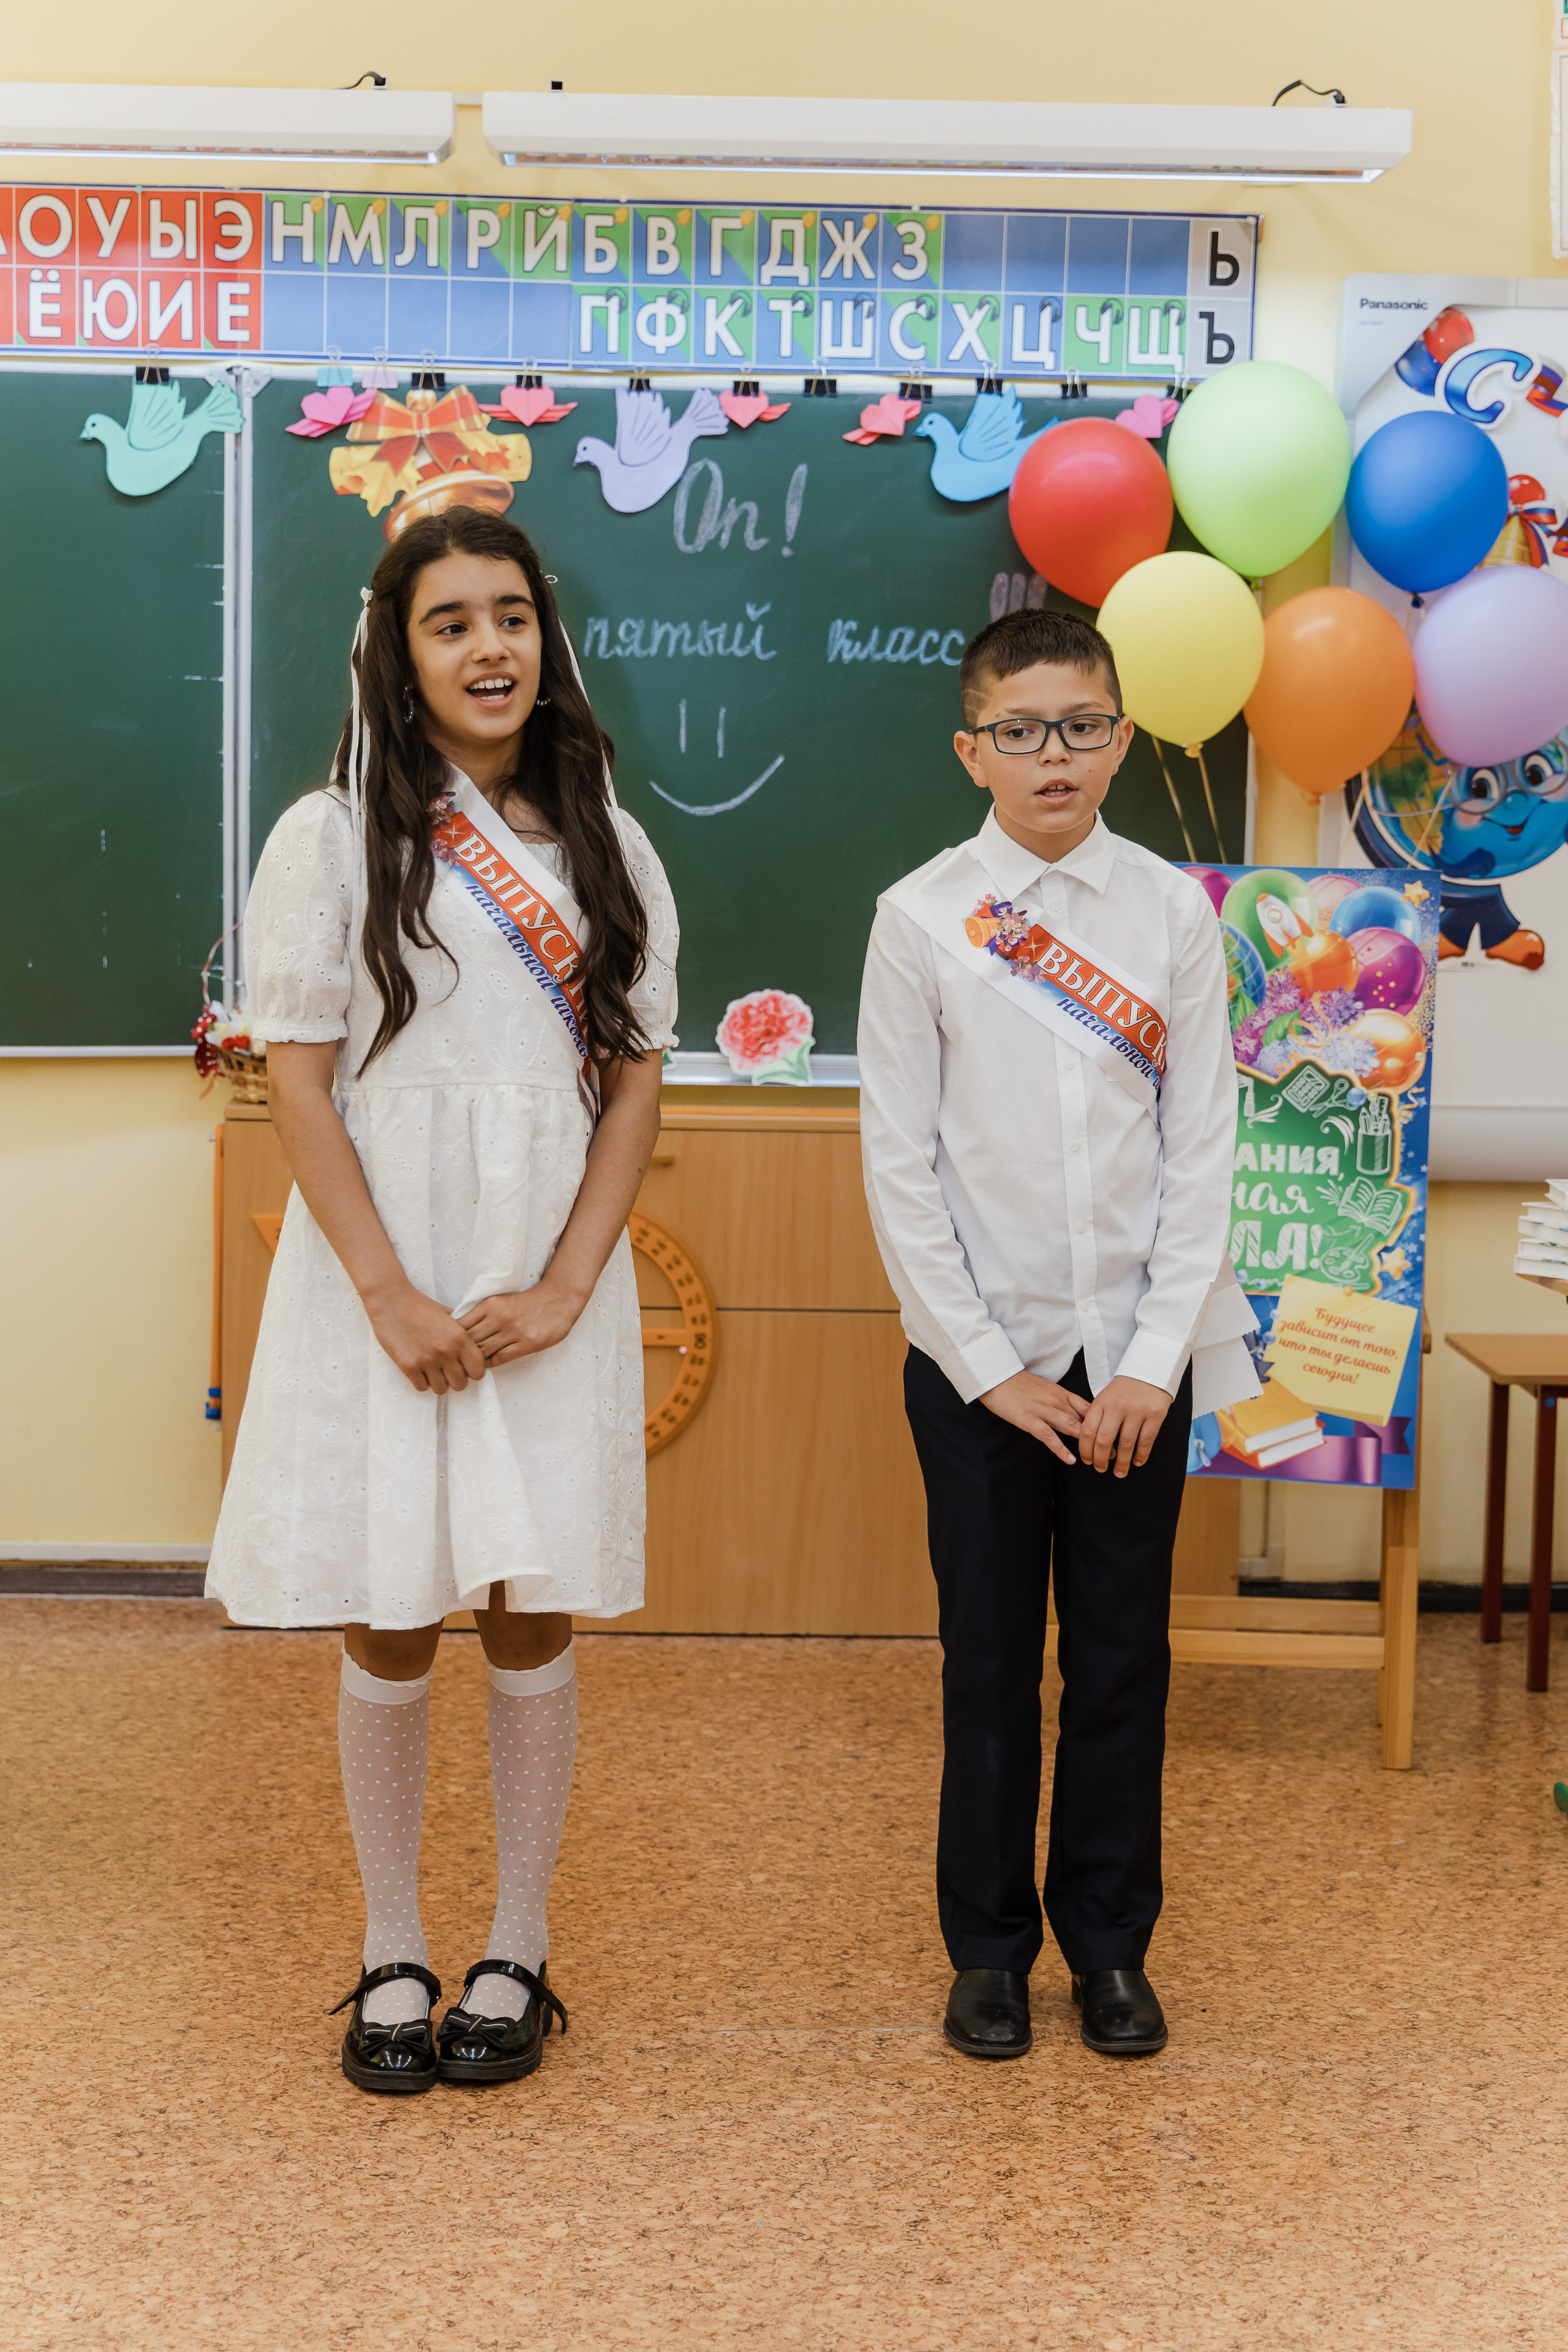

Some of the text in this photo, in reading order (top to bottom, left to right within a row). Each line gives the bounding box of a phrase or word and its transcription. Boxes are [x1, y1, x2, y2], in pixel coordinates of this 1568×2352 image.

[18, 194, 73, 258] О
[86, 197, 131, 258] У
[148, 198, 197, 260] Ы
[214, 199, 254, 262] Э
[271, 200, 315, 263] Н
[328, 202, 385, 266] М
[394, 206, 439, 268] Л
[466, 208, 501, 270] Р
[523, 205, 568, 273] Й
[584, 214, 619, 274] Б
[646, 216, 680, 276] В
[710, 217, 744, 276] Г
[760, 217, 810, 286] Д
[820, 219, 876, 280] Ж
[891, 220, 929, 281] З
[1209, 231, 1240, 286] Ь
[28, 268, 1235, 375] Ё Ю И Е П Ф К Т Ш С Х Ц Ч Щ Ъ
[1360, 298, 1428, 310] Panasonic
[584, 601, 778, 661] пятый
[465, 884, 564, 992] начальной
[1036, 941, 1167, 1071] ВЫПУСК
[1056, 997, 1158, 1079] начальной
[1234, 1142, 1344, 1182] АНИЯ,
[1229, 1219, 1323, 1270] ЛА!
[1277, 1319, 1338, 1342] зависит
[1340, 1335, 1360, 1349] от
[1316, 1307, 1376, 1334] Будущее
[1279, 1337, 1391, 1375] что ты делаешь
[1302, 1362, 1360, 1384] сегодня!
